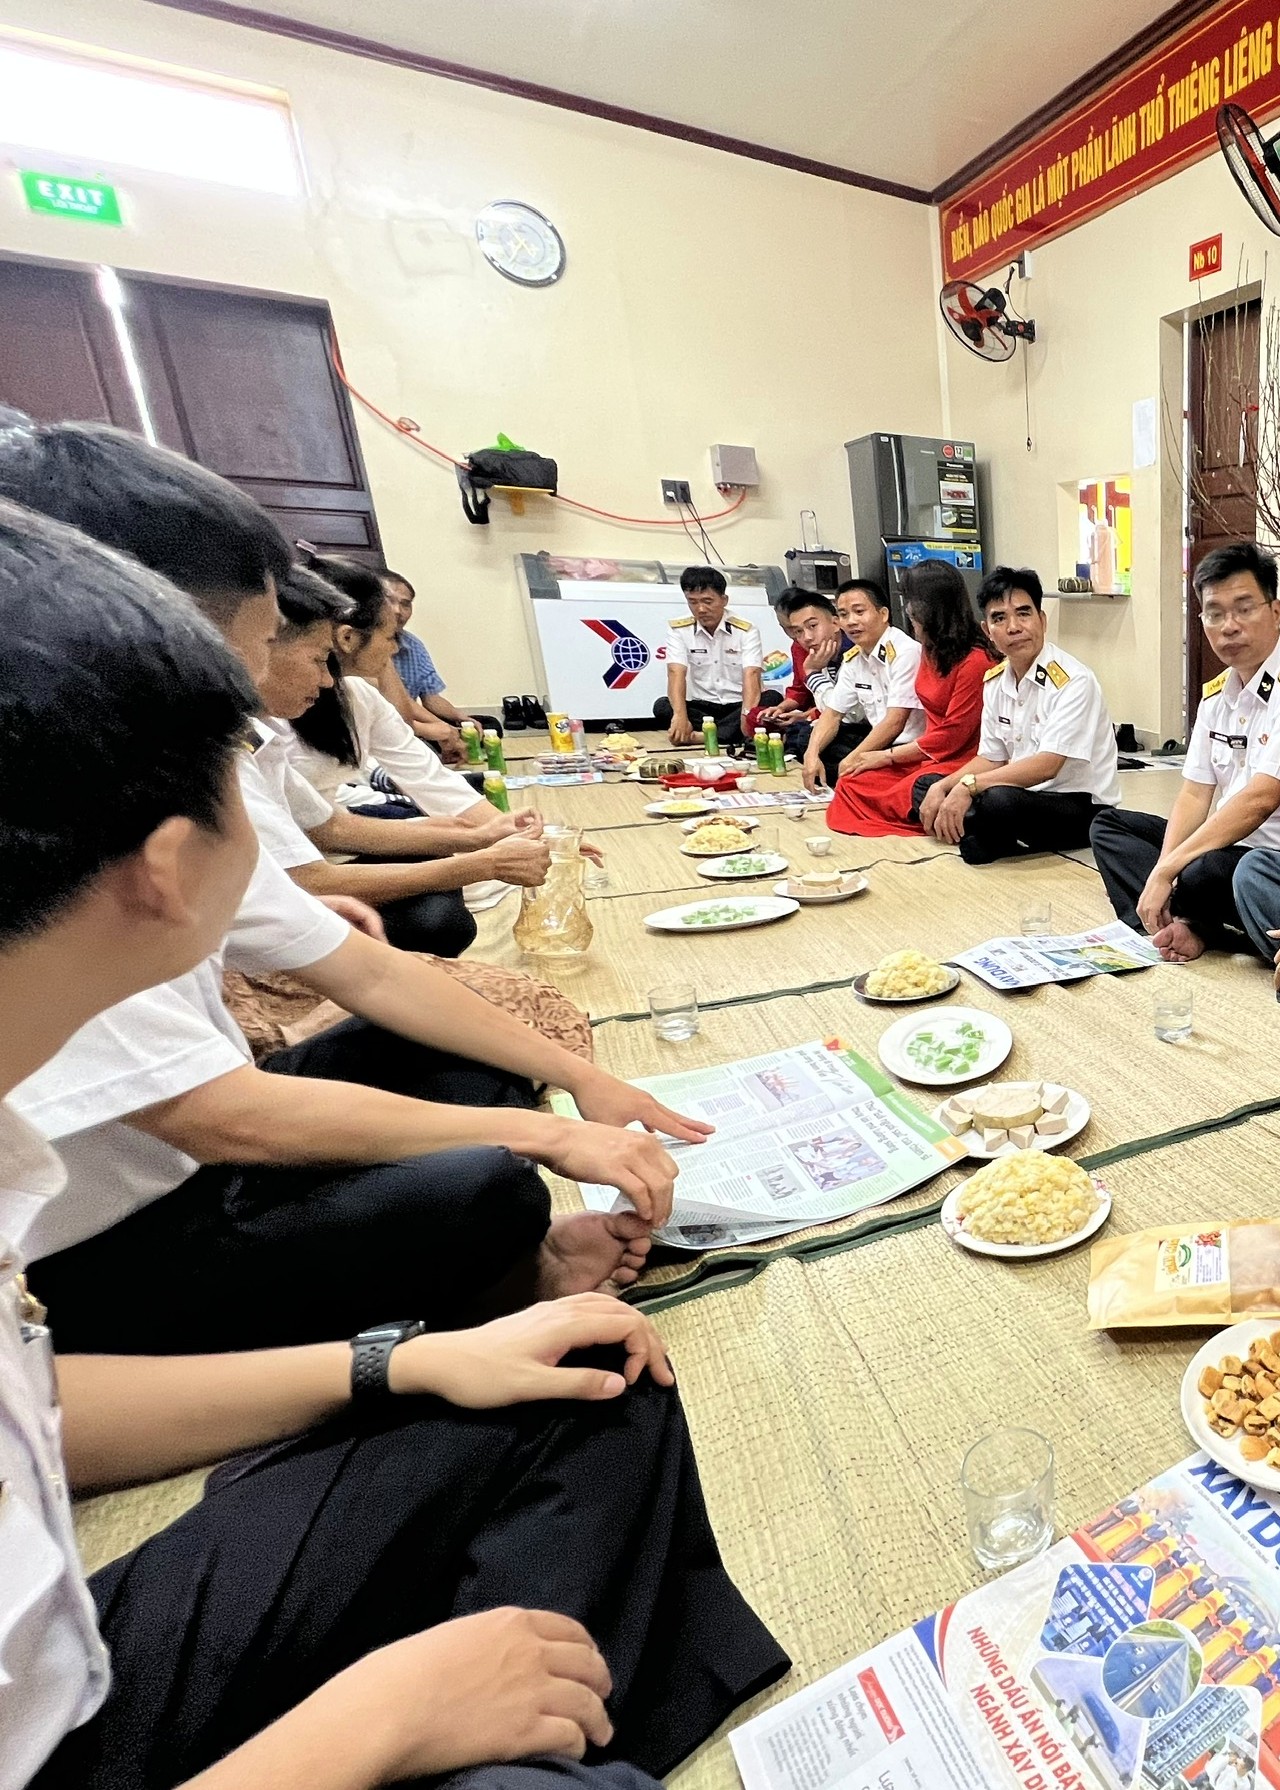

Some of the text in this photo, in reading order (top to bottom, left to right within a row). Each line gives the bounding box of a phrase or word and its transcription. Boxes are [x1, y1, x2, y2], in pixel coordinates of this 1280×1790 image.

[951, 211, 973, 263] BIỂN,
[973, 200, 990, 249] ĐẢO
[991, 183, 1014, 242] QUỐC
[1015, 182, 1032, 224] GIA
[1032, 165, 1046, 215] LÀ
[1046, 152, 1069, 208] MỘT
[1071, 125, 1103, 191] PHẦN
[1105, 115, 1136, 172] LÃNH
[1139, 74, 1165, 150] THỔ
[1168, 60, 1220, 133] THIÊNG
[1224, 21, 1273, 99] LIÊNG
[38, 180, 104, 207] EXIT
[1207, 245, 1217, 266] 10
[967, 1625, 1087, 1790] NHỮNG DẤU ẤN NỔI BẬT
[970, 1683, 1015, 1741] NGÀNH
[1003, 1738, 1036, 1773] XÂY
